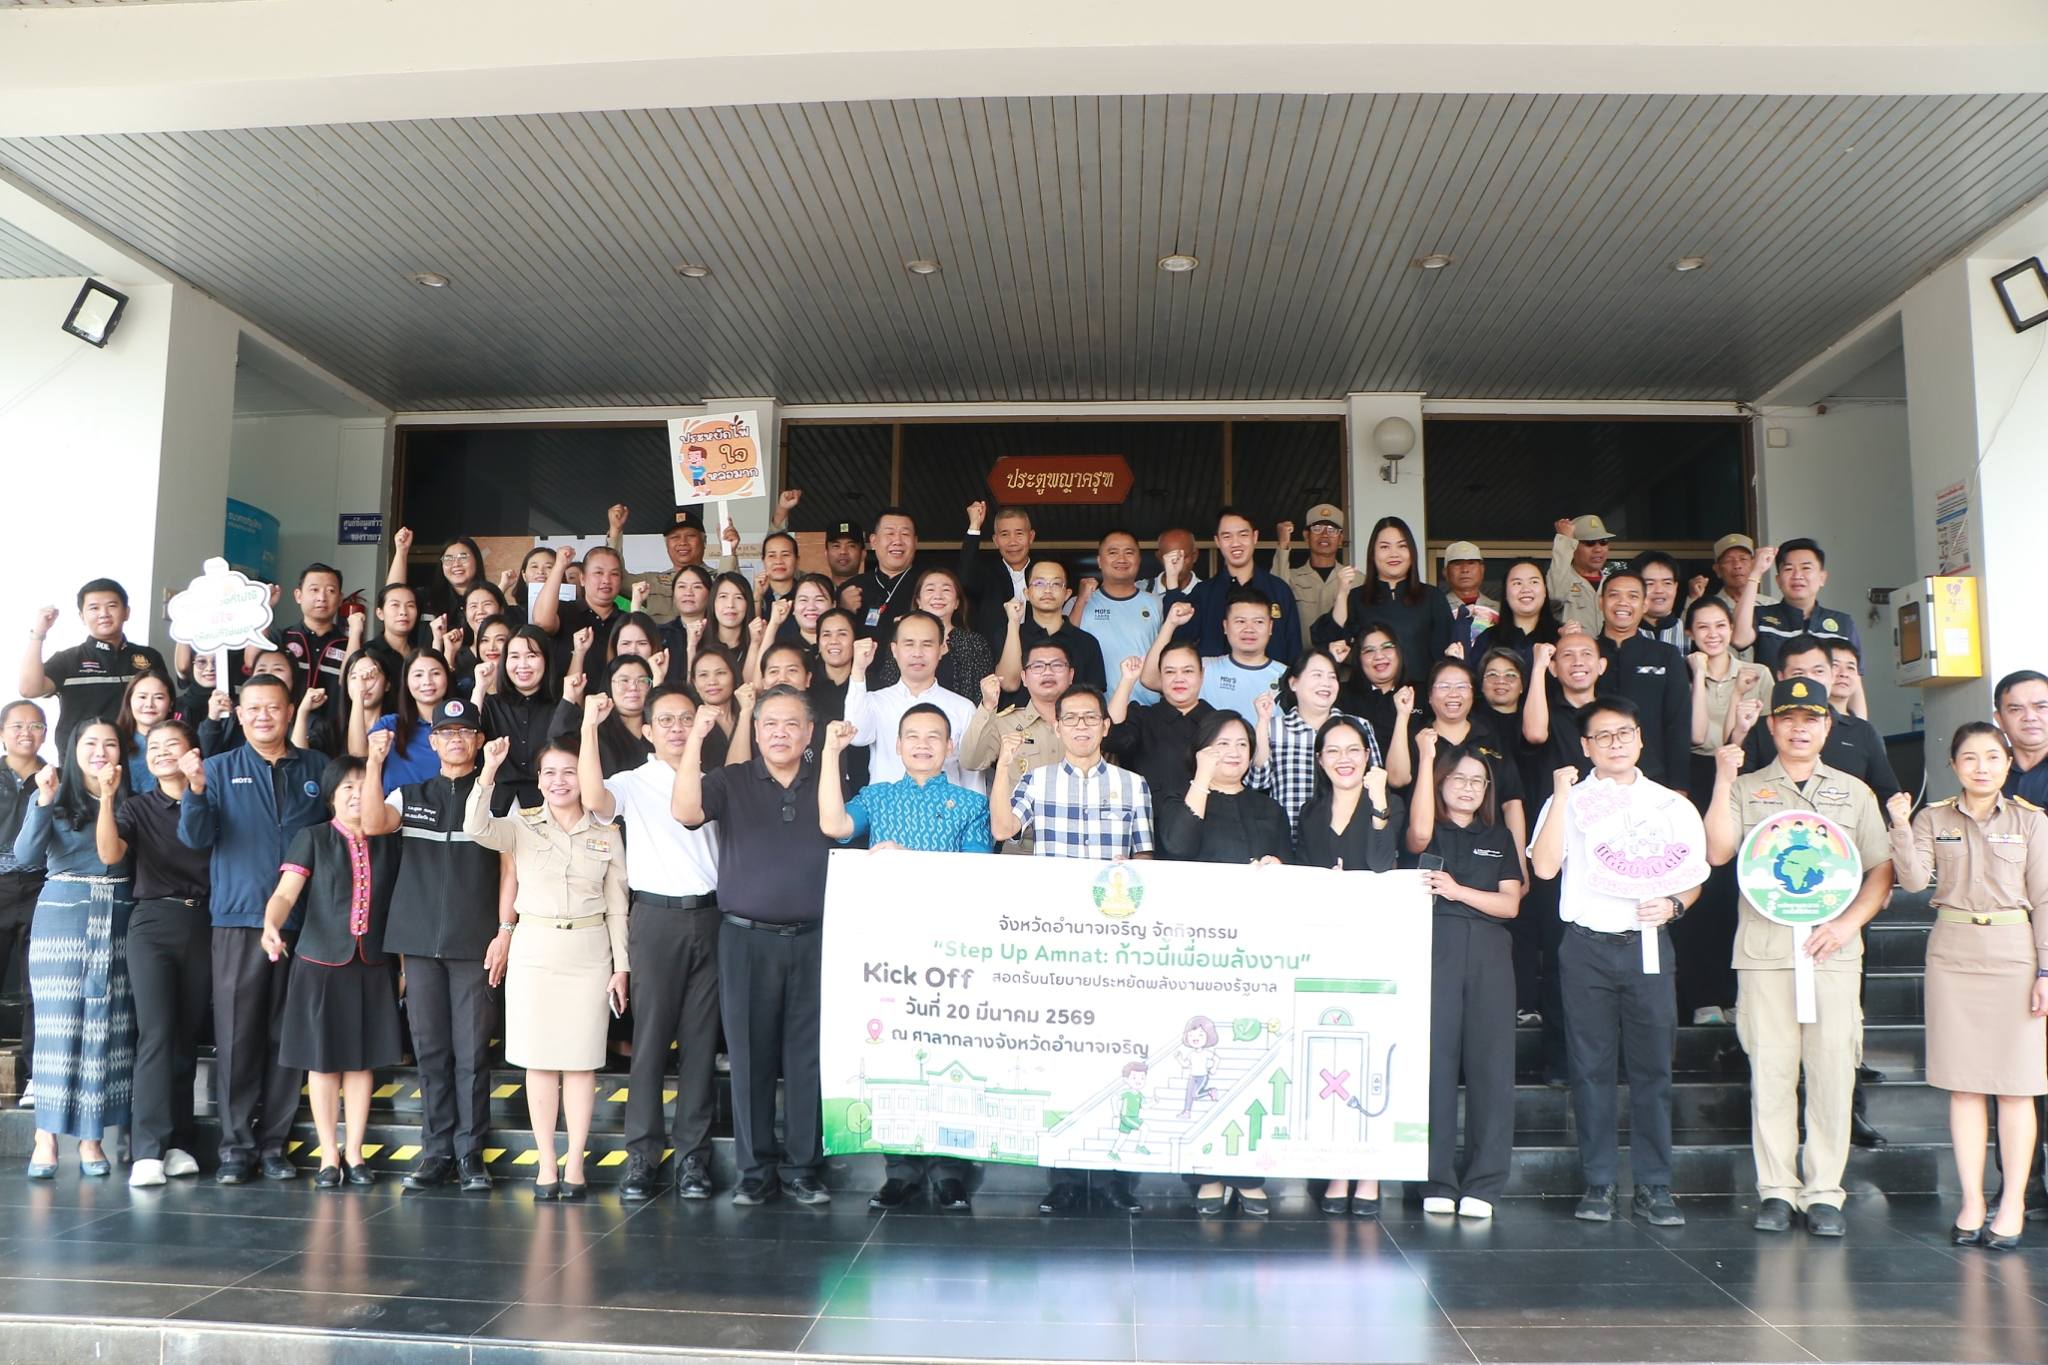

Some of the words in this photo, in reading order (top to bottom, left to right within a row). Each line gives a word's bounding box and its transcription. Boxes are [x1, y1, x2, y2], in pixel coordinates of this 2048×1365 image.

[680, 424, 751, 444] ประหยัดไฟ
[719, 443, 748, 464] ใจ
[707, 463, 760, 481] หล่อมาก
[1006, 467, 1115, 496] ประตูพญาครุฑ
[998, 914, 1147, 940] จังหวัดอำนาจเจริญ
[1152, 920, 1239, 940] จัดกิจกรรม
[1001, 943, 1029, 964] Up
[1034, 944, 1109, 965] Amnat:
[863, 961, 918, 986] Kick
[925, 966, 975, 990] Off
[992, 969, 1278, 997] สอดรับนโยบายประหยัดพลังงานของรัฐบาล
[905, 992, 940, 1017] วันที่
[946, 1003, 970, 1019] 20
[976, 1000, 1040, 1024] มีนาคม
[1045, 1008, 1096, 1025] 2569
[891, 1028, 908, 1041] ณ
[912, 1030, 1149, 1059] ศาลากลางจังหวัดอำนาจเจริญ
